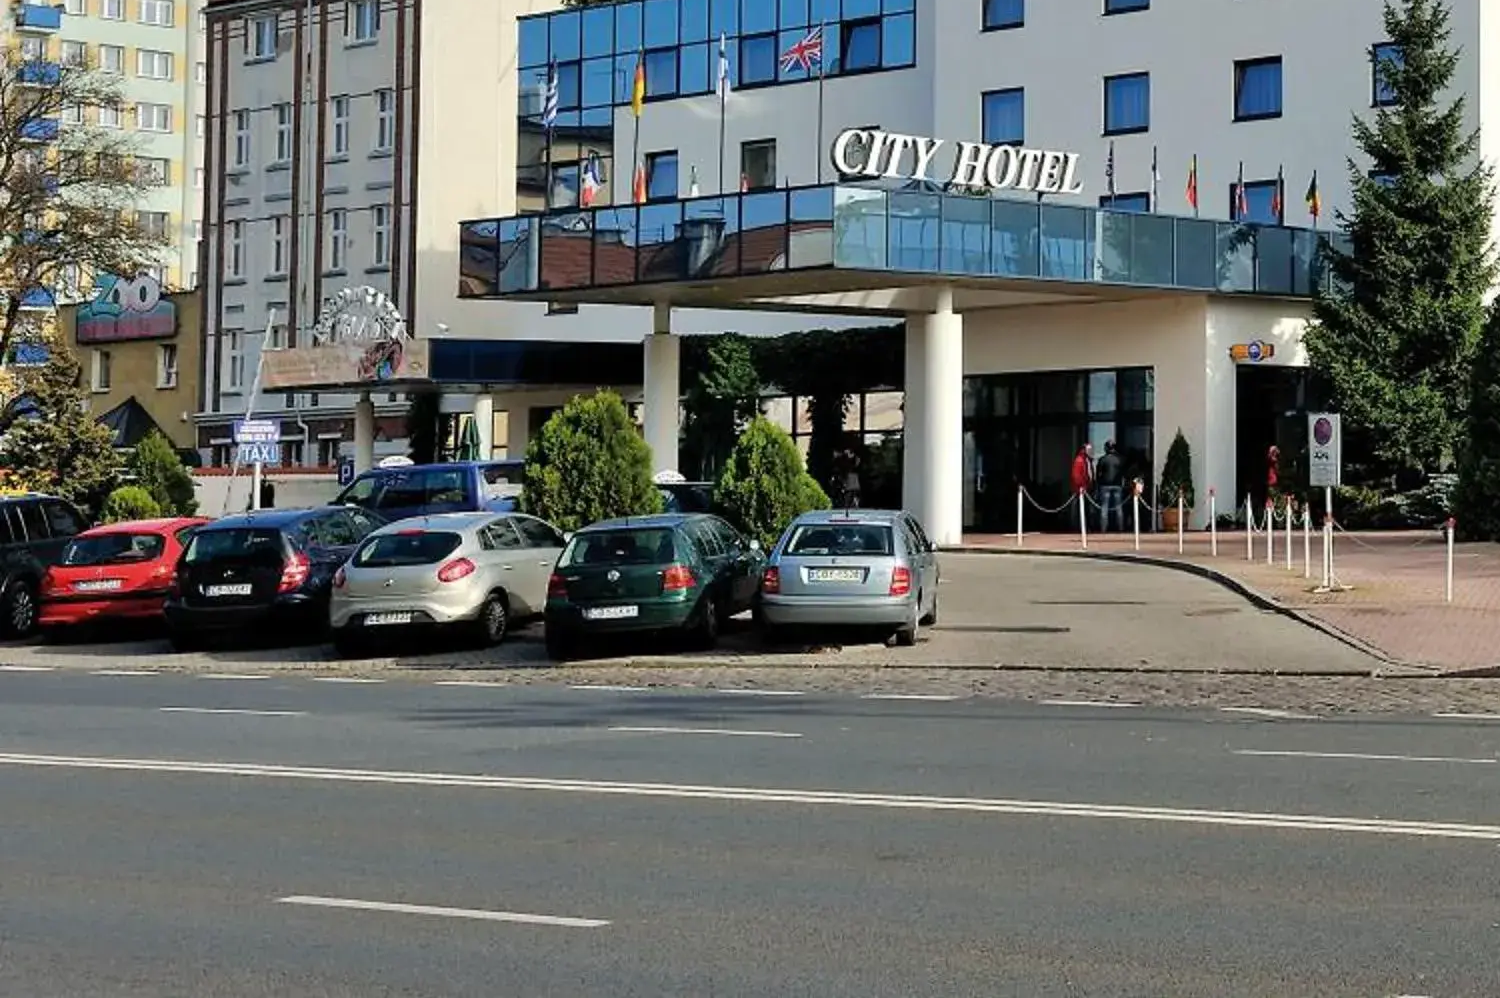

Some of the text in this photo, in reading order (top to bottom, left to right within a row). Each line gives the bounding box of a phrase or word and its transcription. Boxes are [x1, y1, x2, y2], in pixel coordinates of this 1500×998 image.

[832, 129, 1085, 194] CITY HOTEL
[241, 444, 275, 461] TAXI
[341, 465, 351, 483] P
